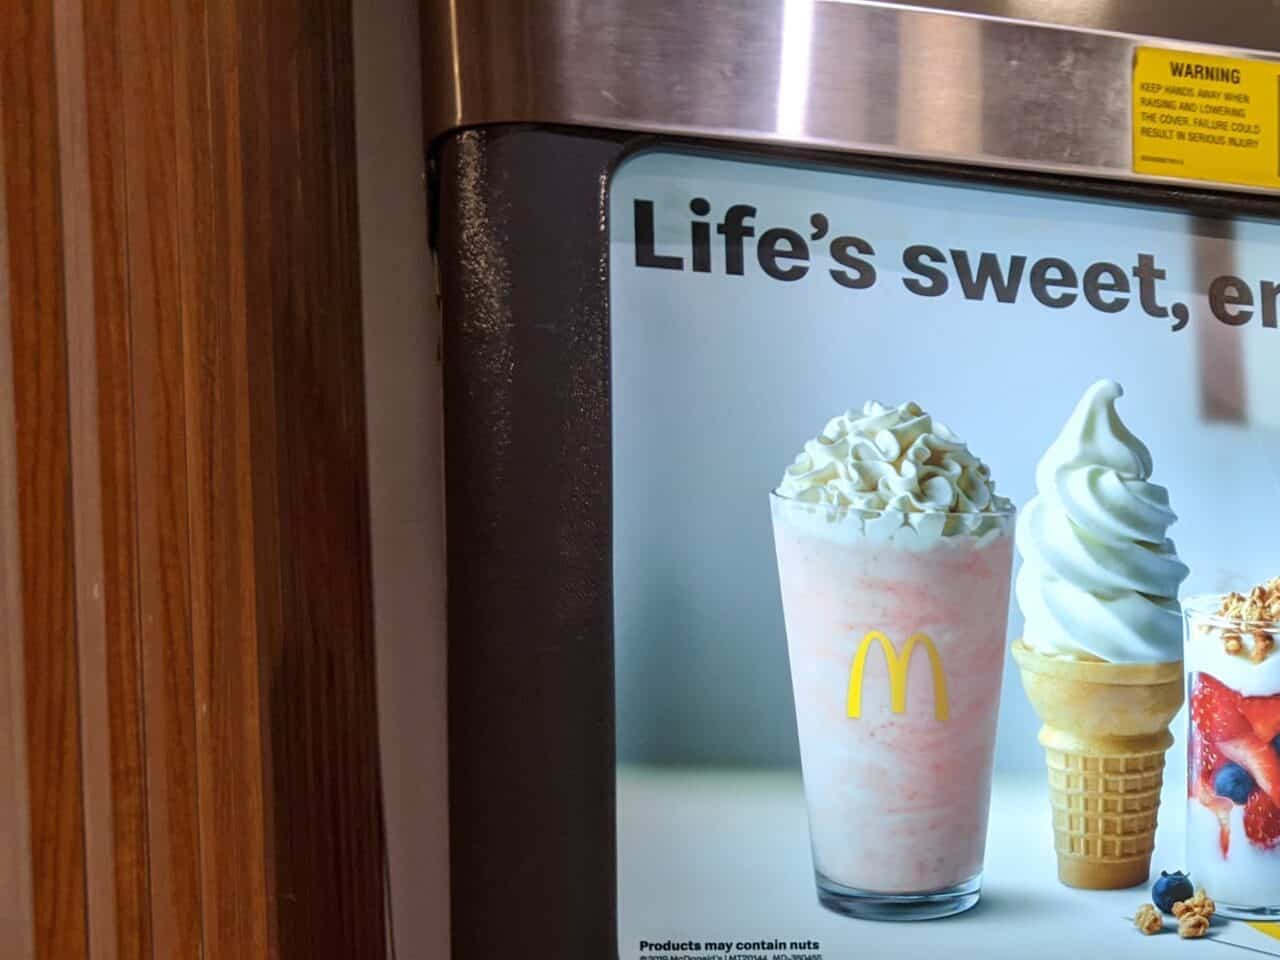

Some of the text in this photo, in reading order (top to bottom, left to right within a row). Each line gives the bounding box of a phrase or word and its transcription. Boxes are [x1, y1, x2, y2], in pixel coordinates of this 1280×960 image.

[1170, 61, 1241, 84] WARNING
[1140, 82, 1250, 104] KEEP HANDS AWAY WHEN
[1140, 97, 1246, 118] RAISING AND LOWERING
[1141, 112, 1157, 122] THE
[1194, 118, 1228, 131] FAILURE
[1231, 122, 1261, 134] COULD
[1141, 126, 1173, 139] RESULT
[1176, 130, 1185, 141] IN
[1188, 131, 1226, 145] SERIOUS
[633, 197, 876, 290] Life’s
[901, 244, 1189, 332] sweet,
[640, 938, 820, 953] Products may contain nuts
